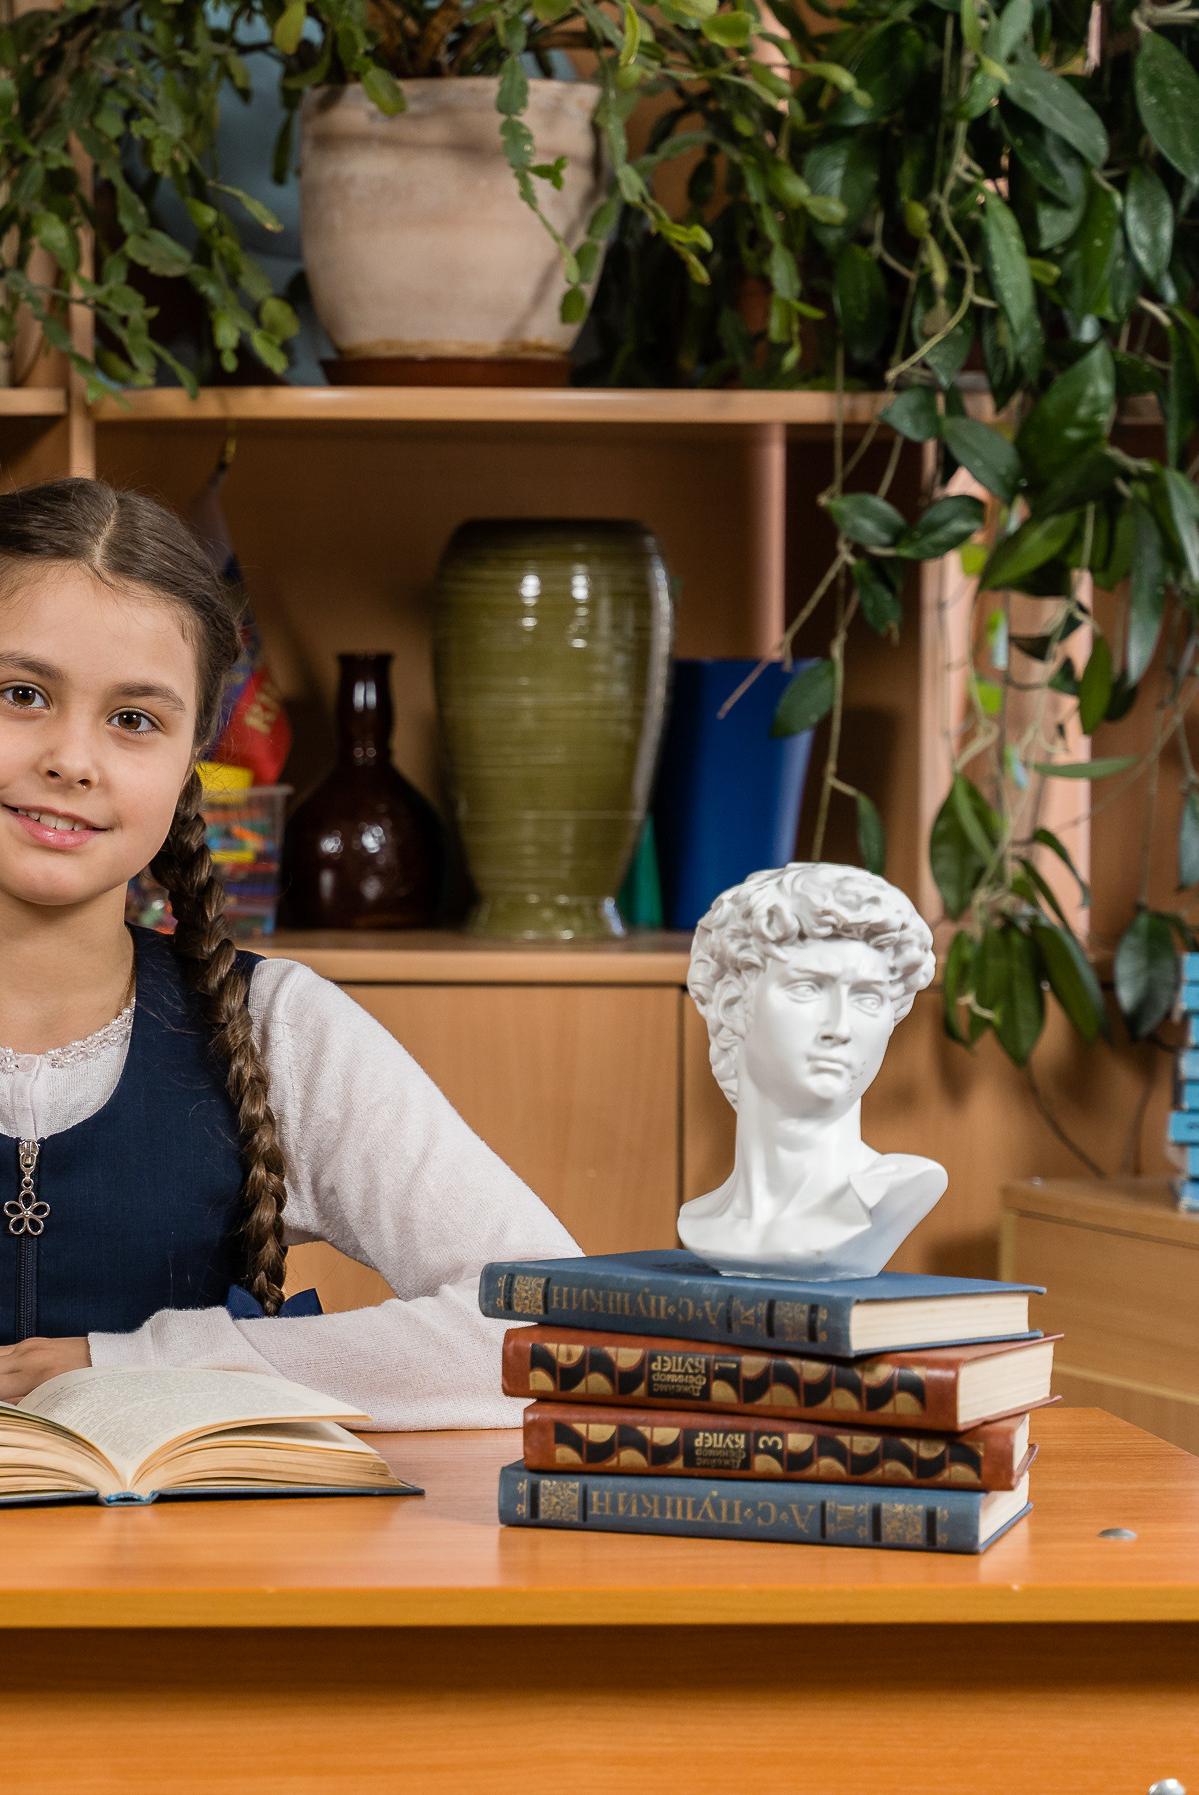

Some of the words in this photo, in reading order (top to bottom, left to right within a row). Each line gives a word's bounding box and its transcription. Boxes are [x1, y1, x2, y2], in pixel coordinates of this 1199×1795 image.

[651, 1355, 706, 1374] КУПЕР
[651, 1372, 707, 1386] Фенимор
[652, 1383, 702, 1397] Джеймс
[694, 1431, 746, 1449] КУПЕР
[758, 1435, 783, 1450] 3
[694, 1448, 746, 1460] Фенимор
[696, 1458, 741, 1470] Джеймс
